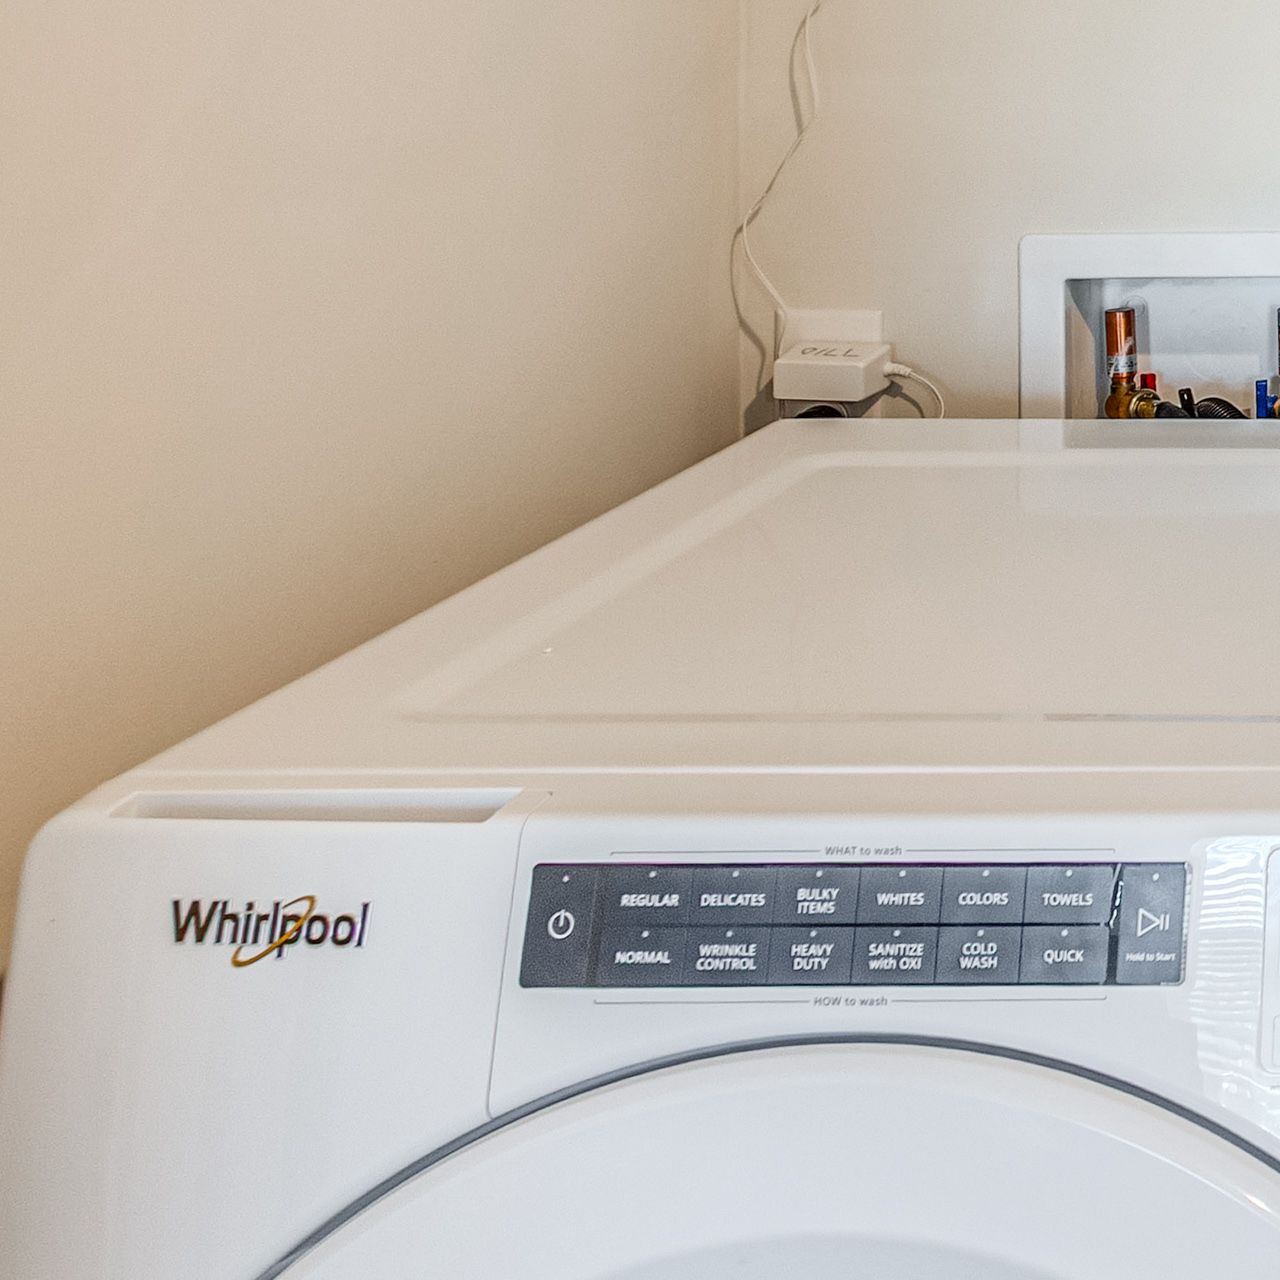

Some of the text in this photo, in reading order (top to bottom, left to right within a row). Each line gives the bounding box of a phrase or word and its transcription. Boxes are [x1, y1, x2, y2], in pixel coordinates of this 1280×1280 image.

[825, 846, 857, 856] WHAT
[874, 846, 903, 856] wash
[620, 893, 680, 908] REGULAR
[700, 893, 766, 908] DELICATES
[796, 888, 840, 902] BULKY
[876, 892, 925, 906] WHITES
[957, 892, 1009, 906] COLORS
[1043, 892, 1094, 907] TOWELS
[797, 901, 836, 915] ITEMS
[172, 898, 371, 961] Whirlpool
[699, 943, 757, 957] WRINKLE
[791, 943, 834, 957] HEAVY
[868, 942, 925, 956] SANITIZE
[961, 942, 997, 956] COLD
[615, 950, 671, 964] NORMAL
[868, 956, 923, 971] with OXI
[959, 956, 998, 970] WASH
[1043, 948, 1084, 965] QUICK
[696, 957, 757, 971] CONTROL
[793, 957, 830, 971] DUTY
[813, 995, 842, 1006] HOW
[860, 995, 888, 1006] wash
